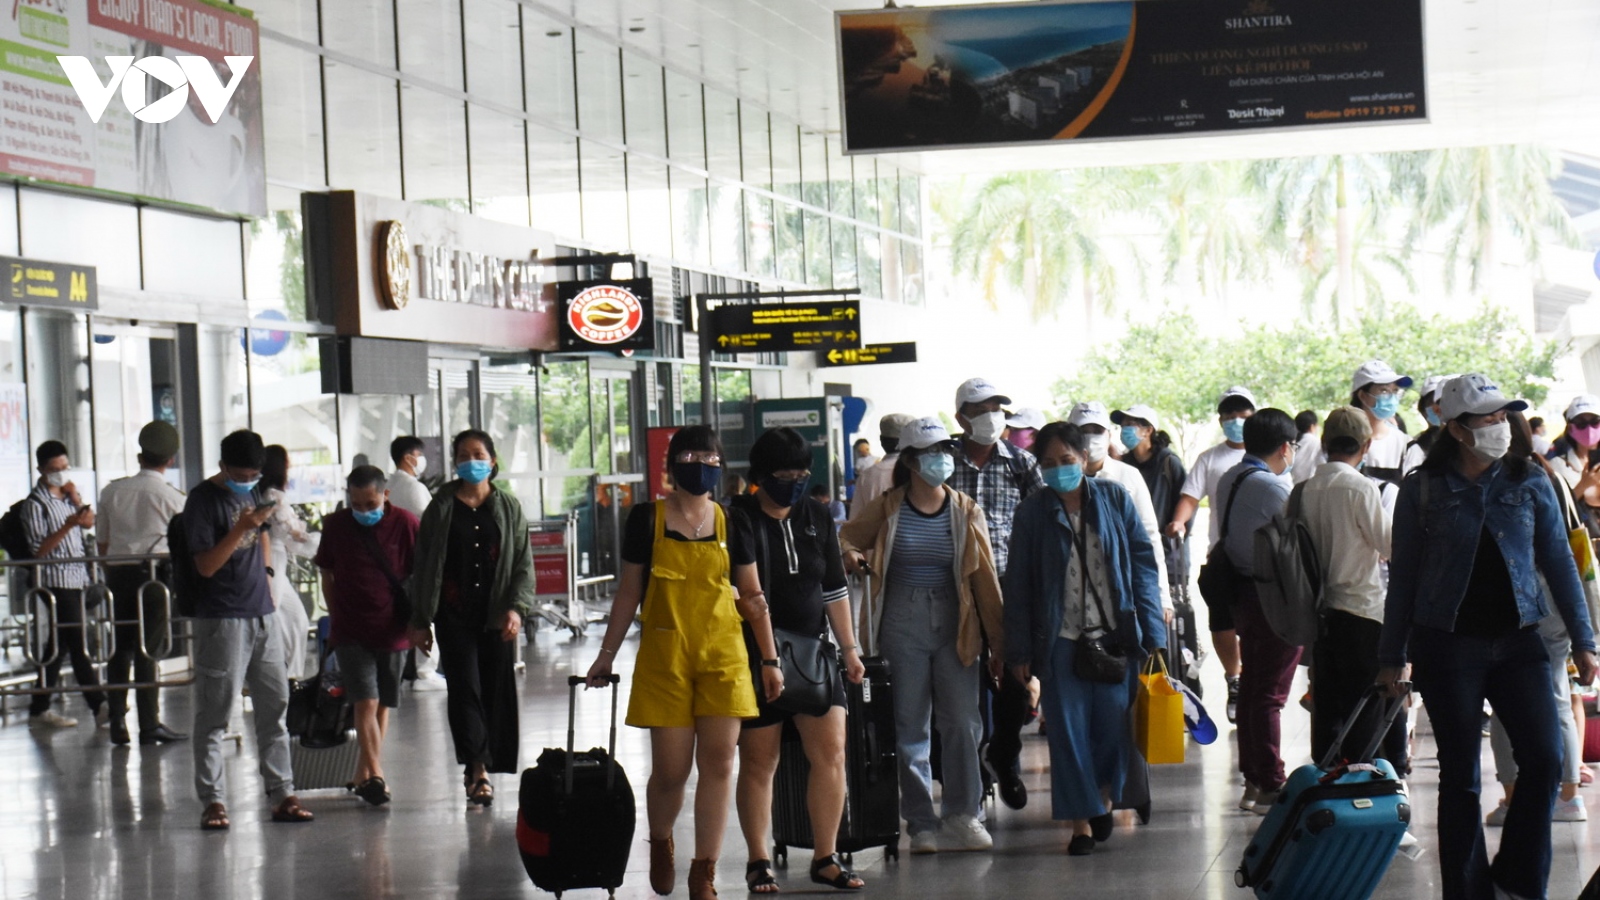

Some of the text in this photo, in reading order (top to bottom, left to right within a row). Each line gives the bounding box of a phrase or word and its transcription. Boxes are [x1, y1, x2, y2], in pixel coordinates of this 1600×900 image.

[1224, 14, 1293, 30] SHANTIRA
[186, 8, 224, 50] LOCAL
[224, 20, 254, 56] FOOD
[1227, 108, 1255, 119] Dusit
[1305, 110, 1341, 119] Hotline
[572, 288, 639, 314] HIGHLANDS
[580, 324, 631, 341] COFFEE
